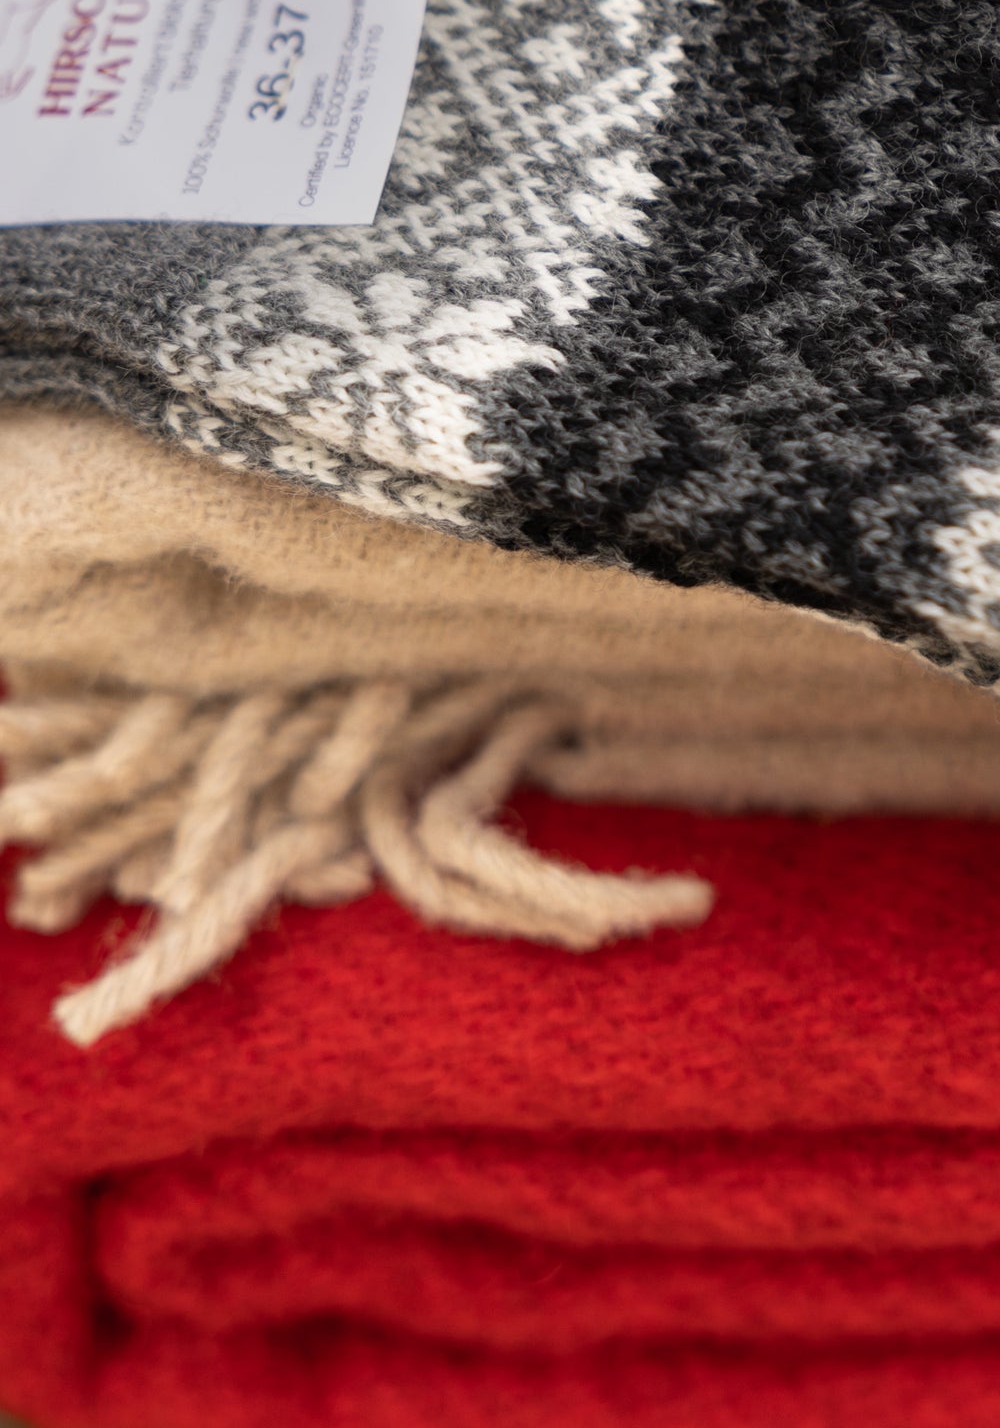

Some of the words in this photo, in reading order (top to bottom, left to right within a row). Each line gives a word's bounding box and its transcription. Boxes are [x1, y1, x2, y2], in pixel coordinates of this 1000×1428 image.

[248, 3, 310, 122] 36-37
[300, 74, 329, 128] Organic
[334, 113, 364, 169] Licence
[350, 85, 372, 112] No.
[182, 151, 212, 195] 100%
[298, 152, 330, 208] Certified
[317, 131, 339, 150] by
